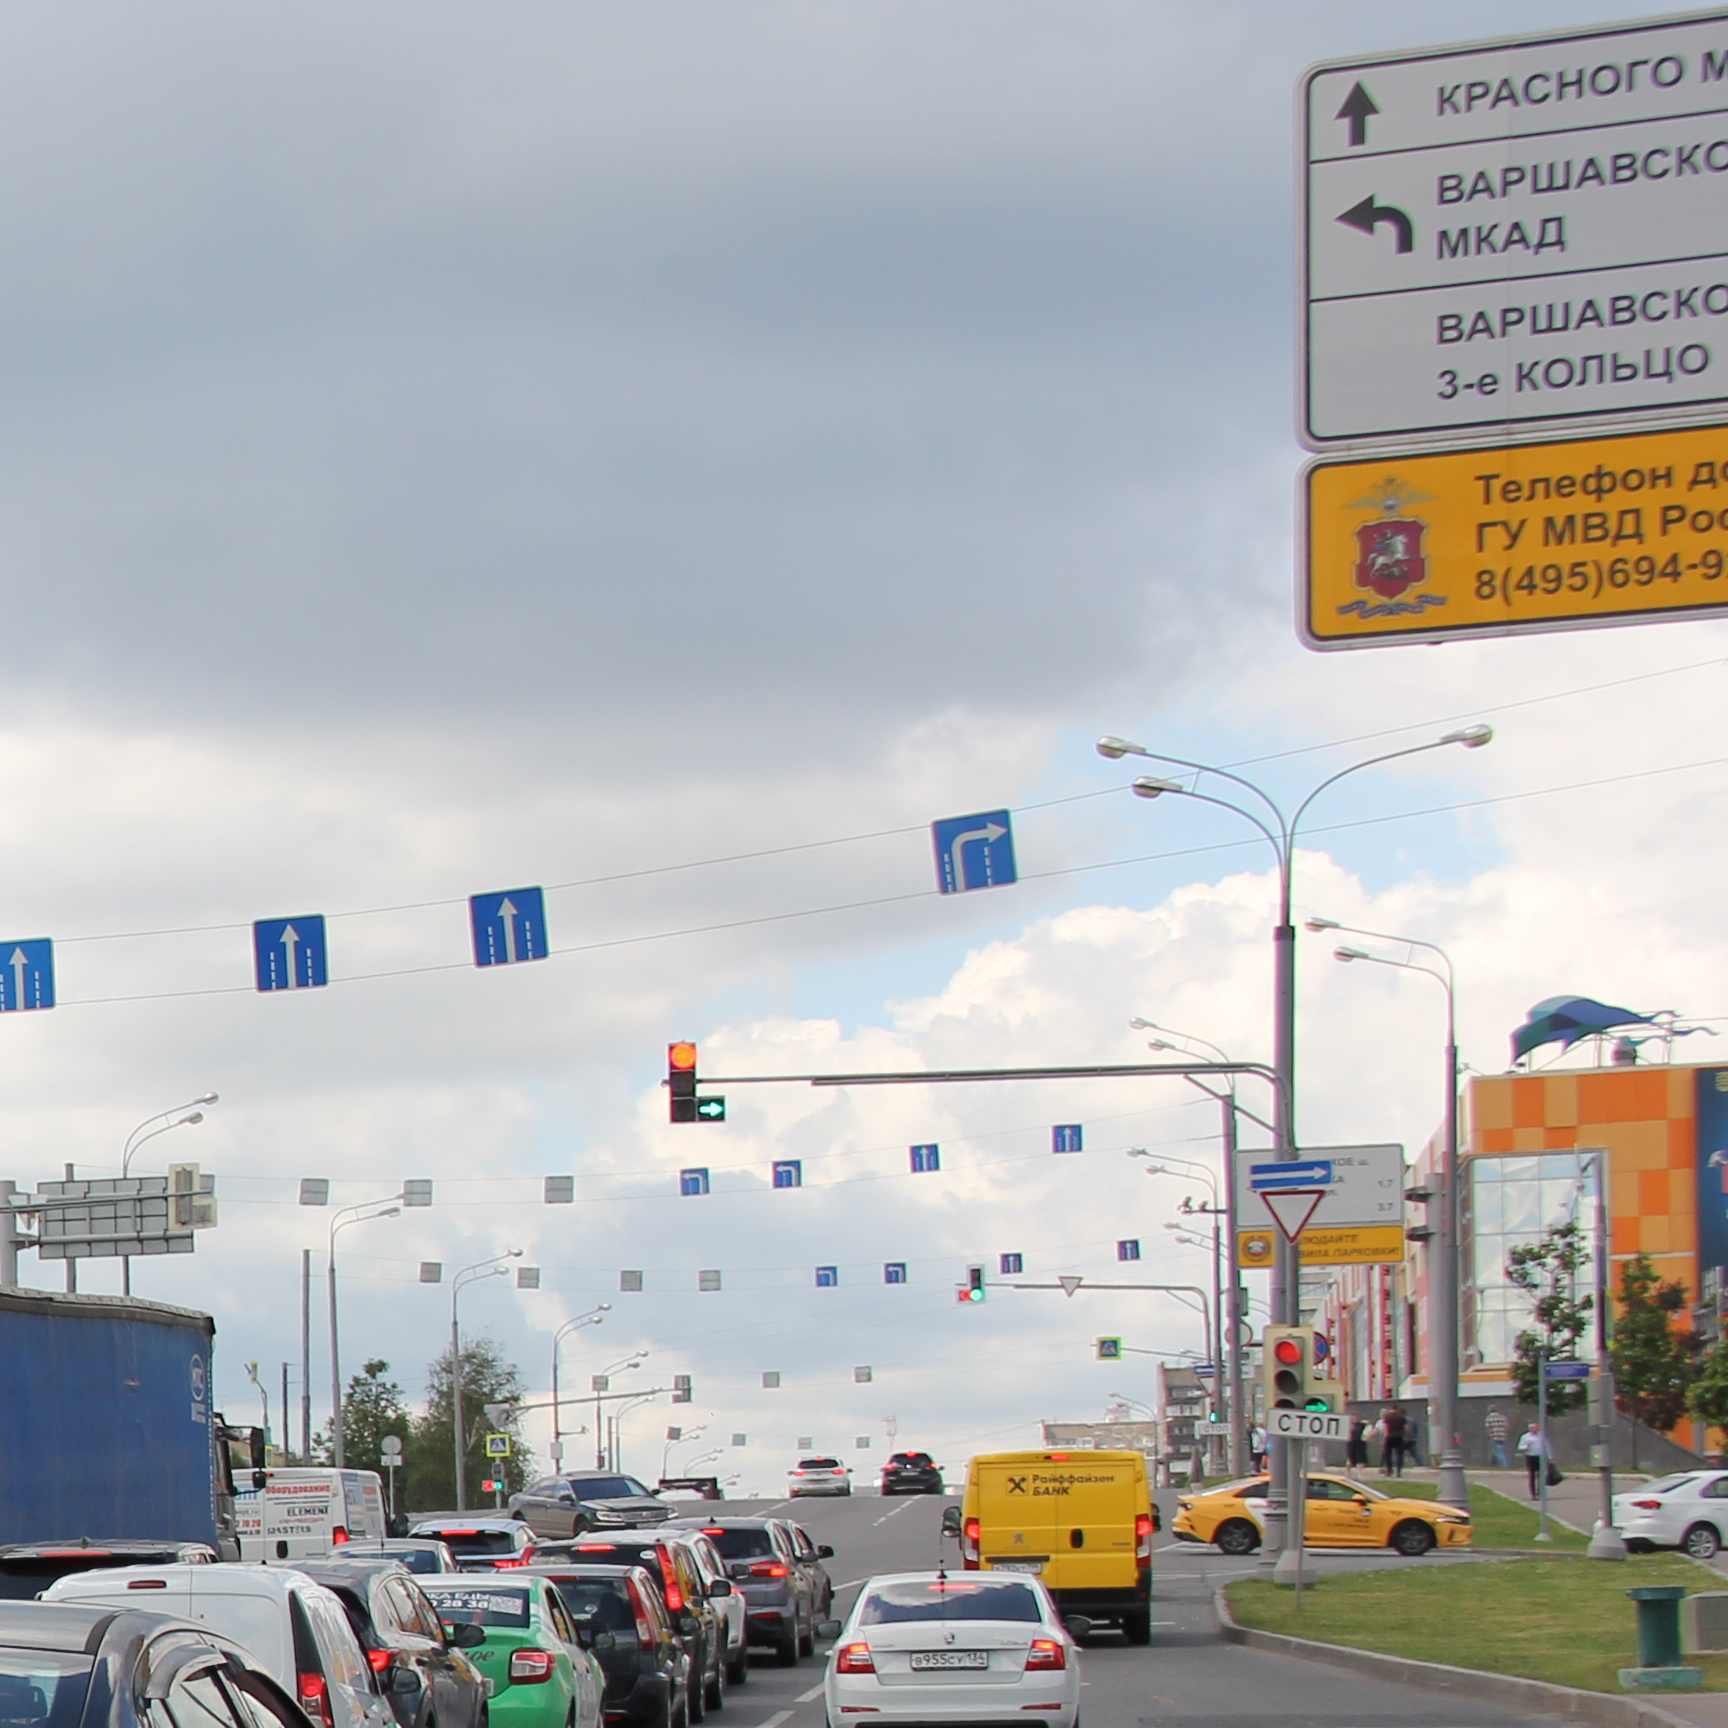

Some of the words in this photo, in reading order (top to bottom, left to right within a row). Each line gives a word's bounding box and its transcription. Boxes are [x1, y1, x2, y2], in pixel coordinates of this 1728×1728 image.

[1436, 56, 1684, 117] КРАСНОГО
[1436, 141, 1728, 206] ВАРШАВСКО
[1436, 216, 1566, 261] МКАД
[1436, 284, 1728, 345] ВАРШАВСКО
[1437, 370, 1500, 400] 3-е
[1515, 344, 1710, 394] КОЛЬЦО
[1476, 463, 1674, 506] Телефон
[1476, 514, 1528, 554] ГУ
[1543, 507, 1644, 547] МВД
[1476, 548, 1728, 606] 8(495)694-9
[1277, 1413, 1340, 1436] СТОП
[1032, 1474, 1115, 1486] Райффайзен
[1032, 1486, 1070, 1497] БАНК
